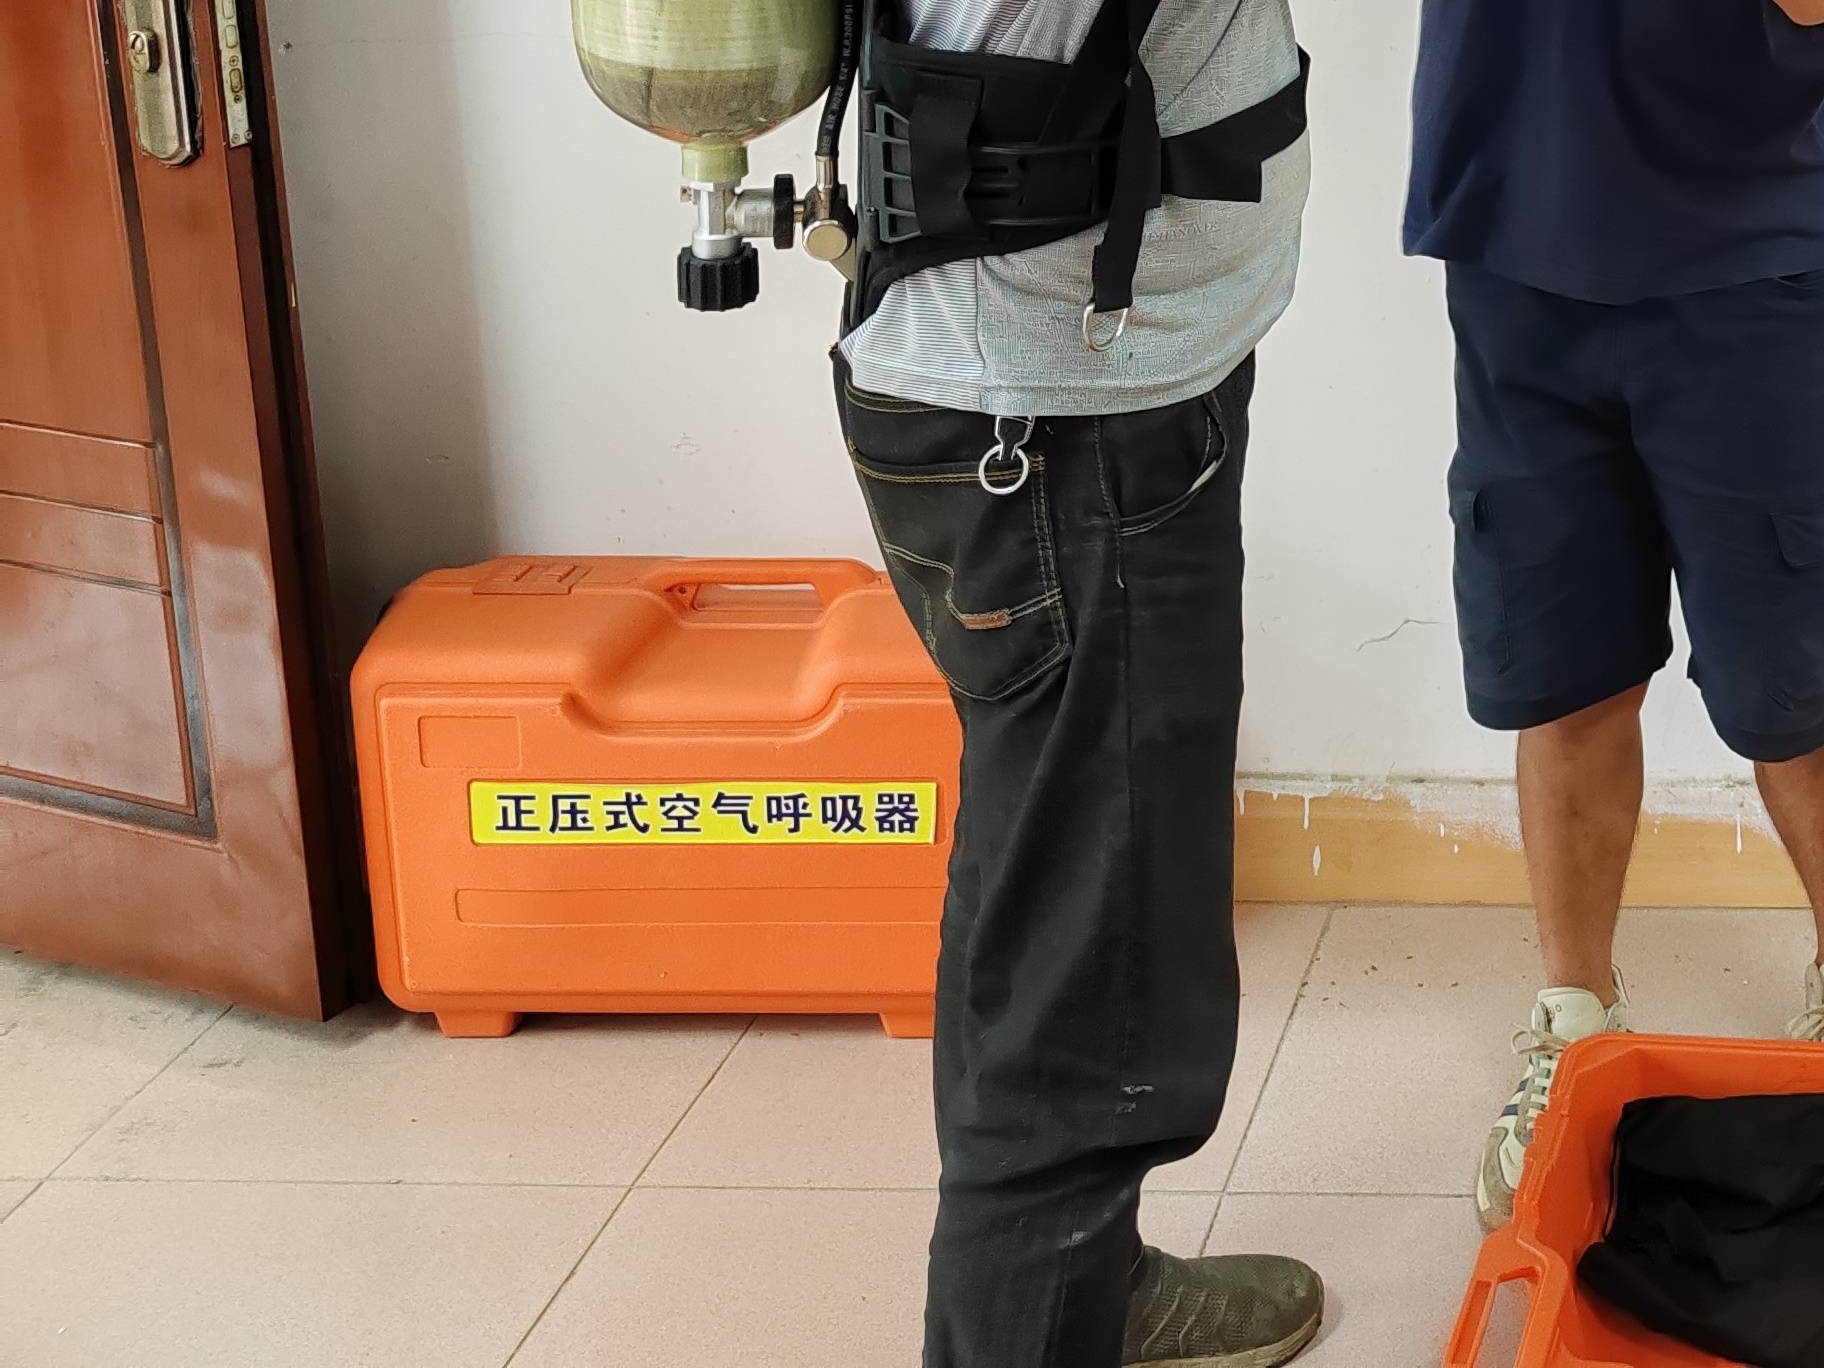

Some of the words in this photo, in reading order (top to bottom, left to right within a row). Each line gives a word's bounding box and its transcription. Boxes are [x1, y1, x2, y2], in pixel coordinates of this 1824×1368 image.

[494, 790, 921, 835] 正压式空气呼吸器
